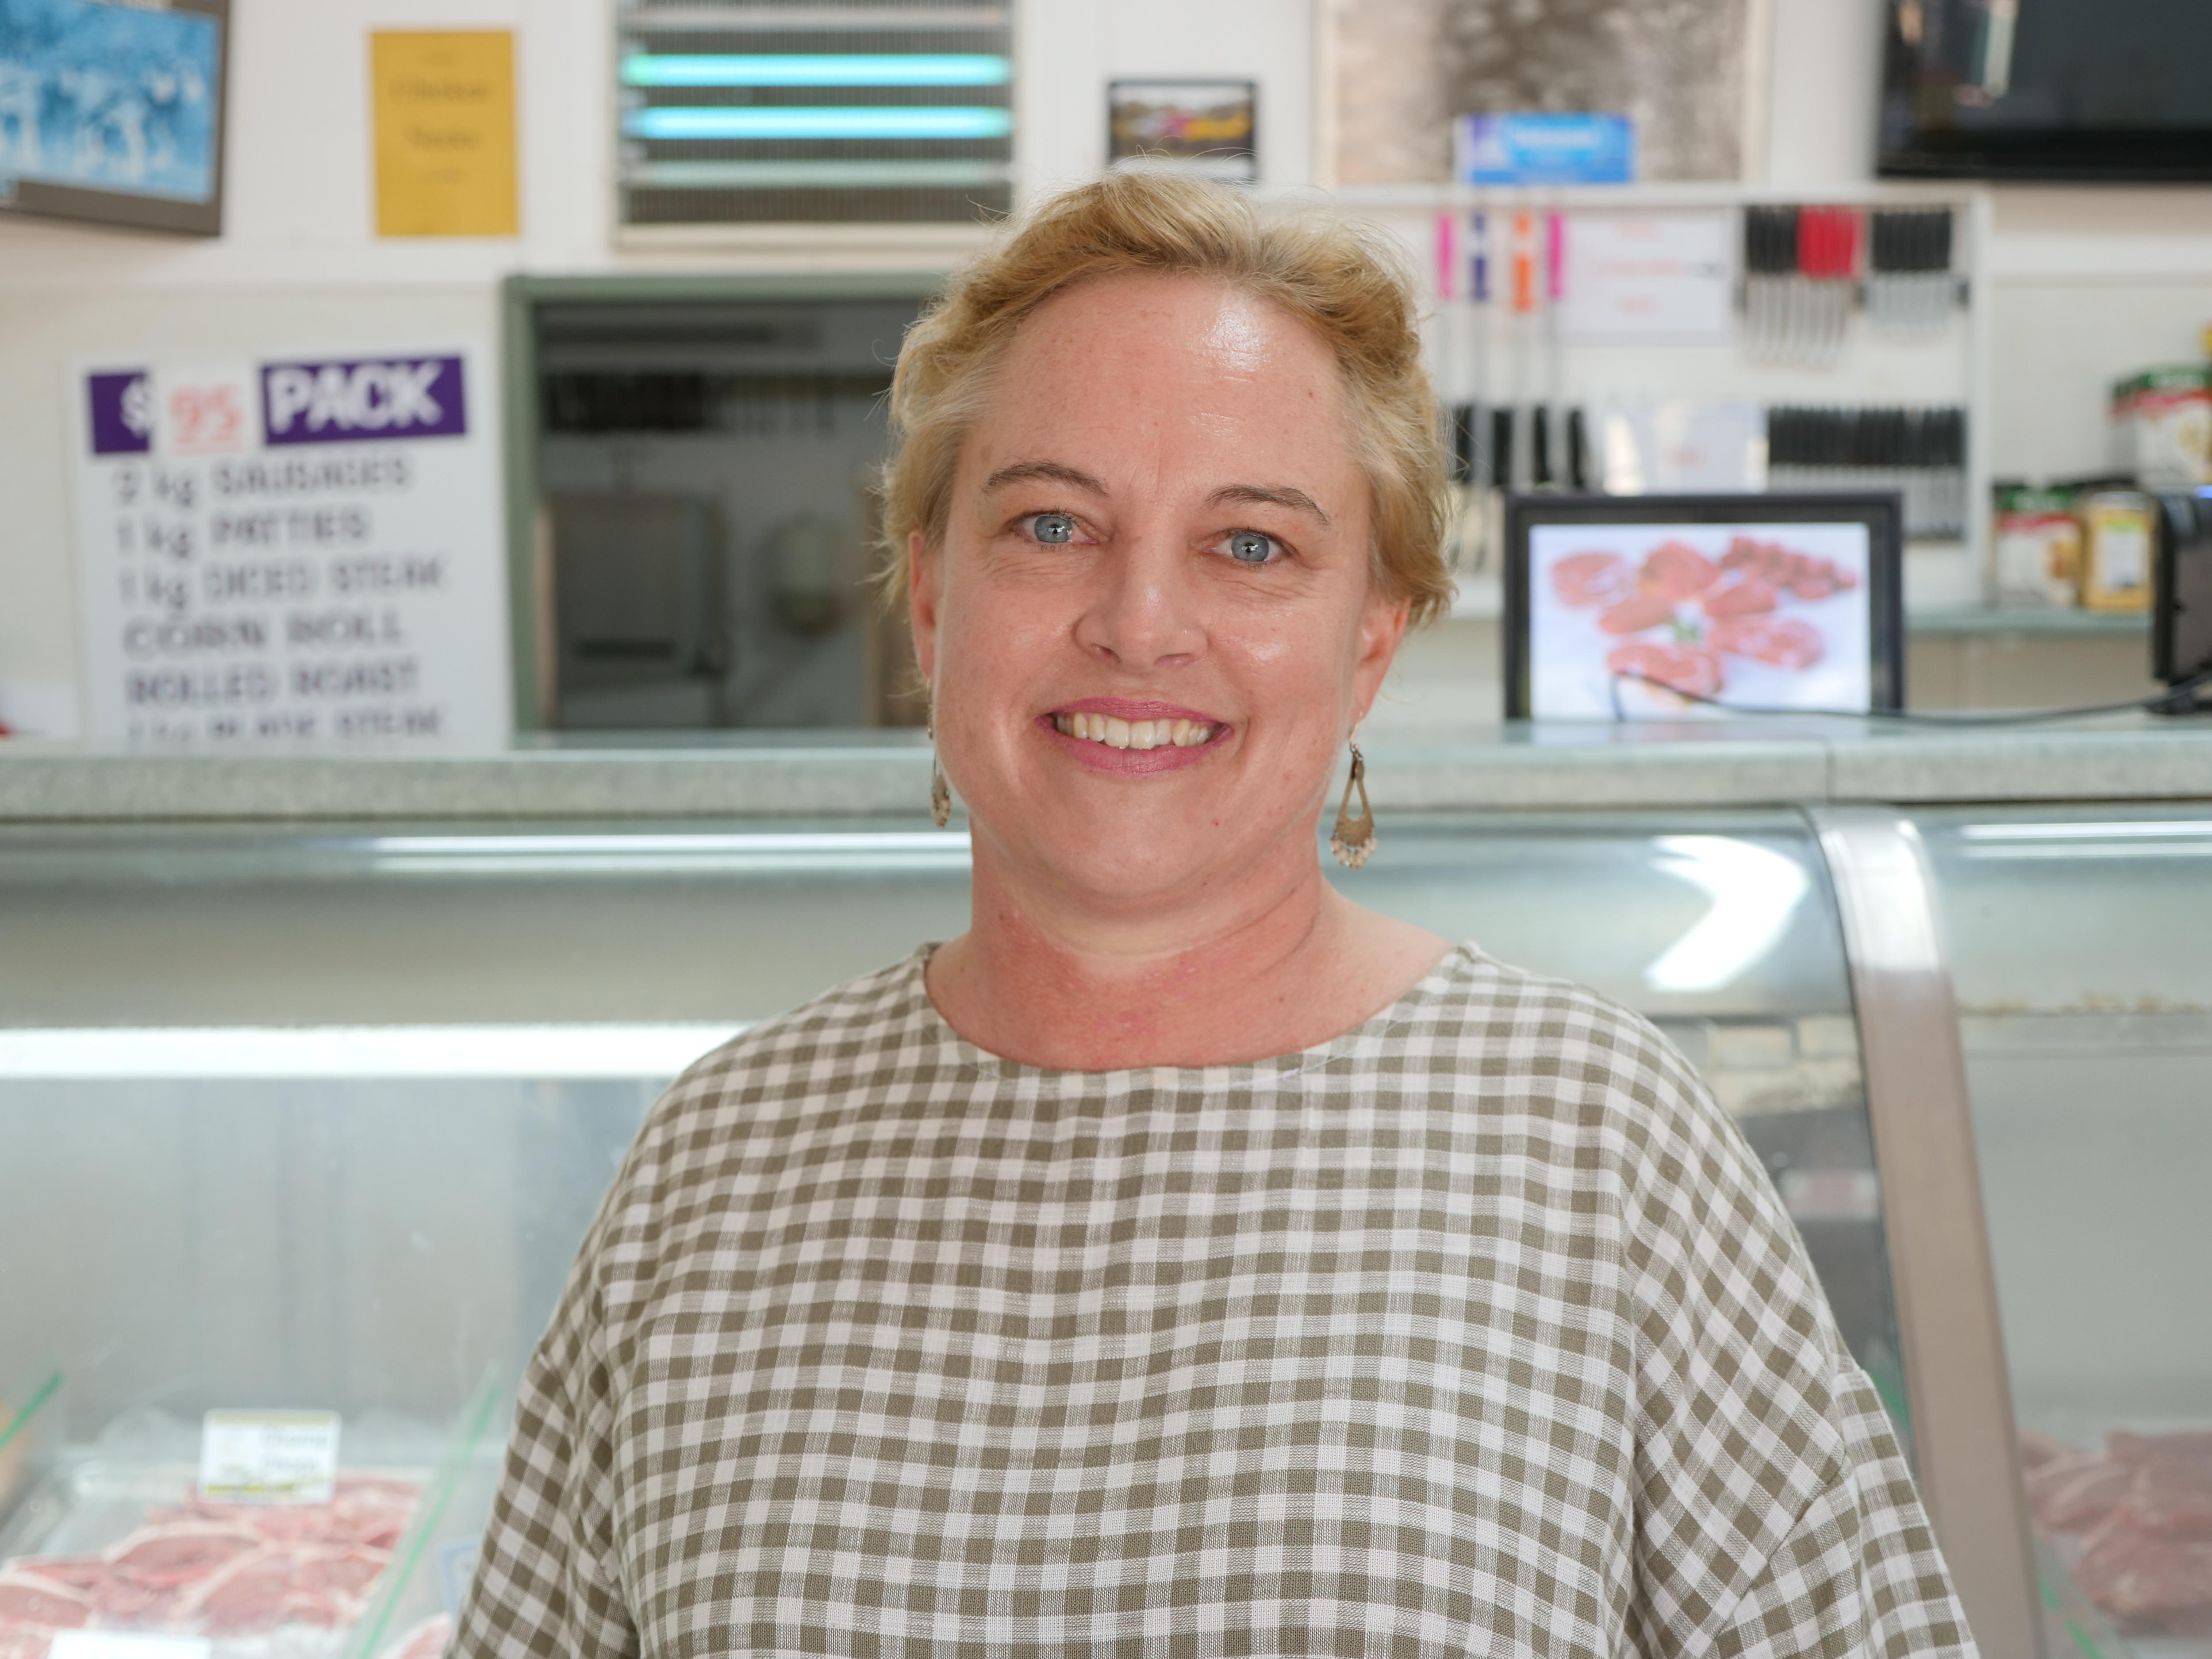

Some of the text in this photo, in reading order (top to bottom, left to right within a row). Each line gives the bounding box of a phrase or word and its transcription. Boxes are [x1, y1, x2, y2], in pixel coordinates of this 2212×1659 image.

[270, 364, 444, 431] PACK
[112, 449, 415, 514] 2 kg SAUSAGES
[144, 512, 199, 566] kg
[210, 504, 373, 553] PATTIES
[144, 565, 195, 618] kg
[203, 558, 318, 605] DICED
[329, 552, 452, 599] STEAK
[121, 607, 411, 660] CORN ROLL
[125, 656, 422, 711] ROLLED ROAST
